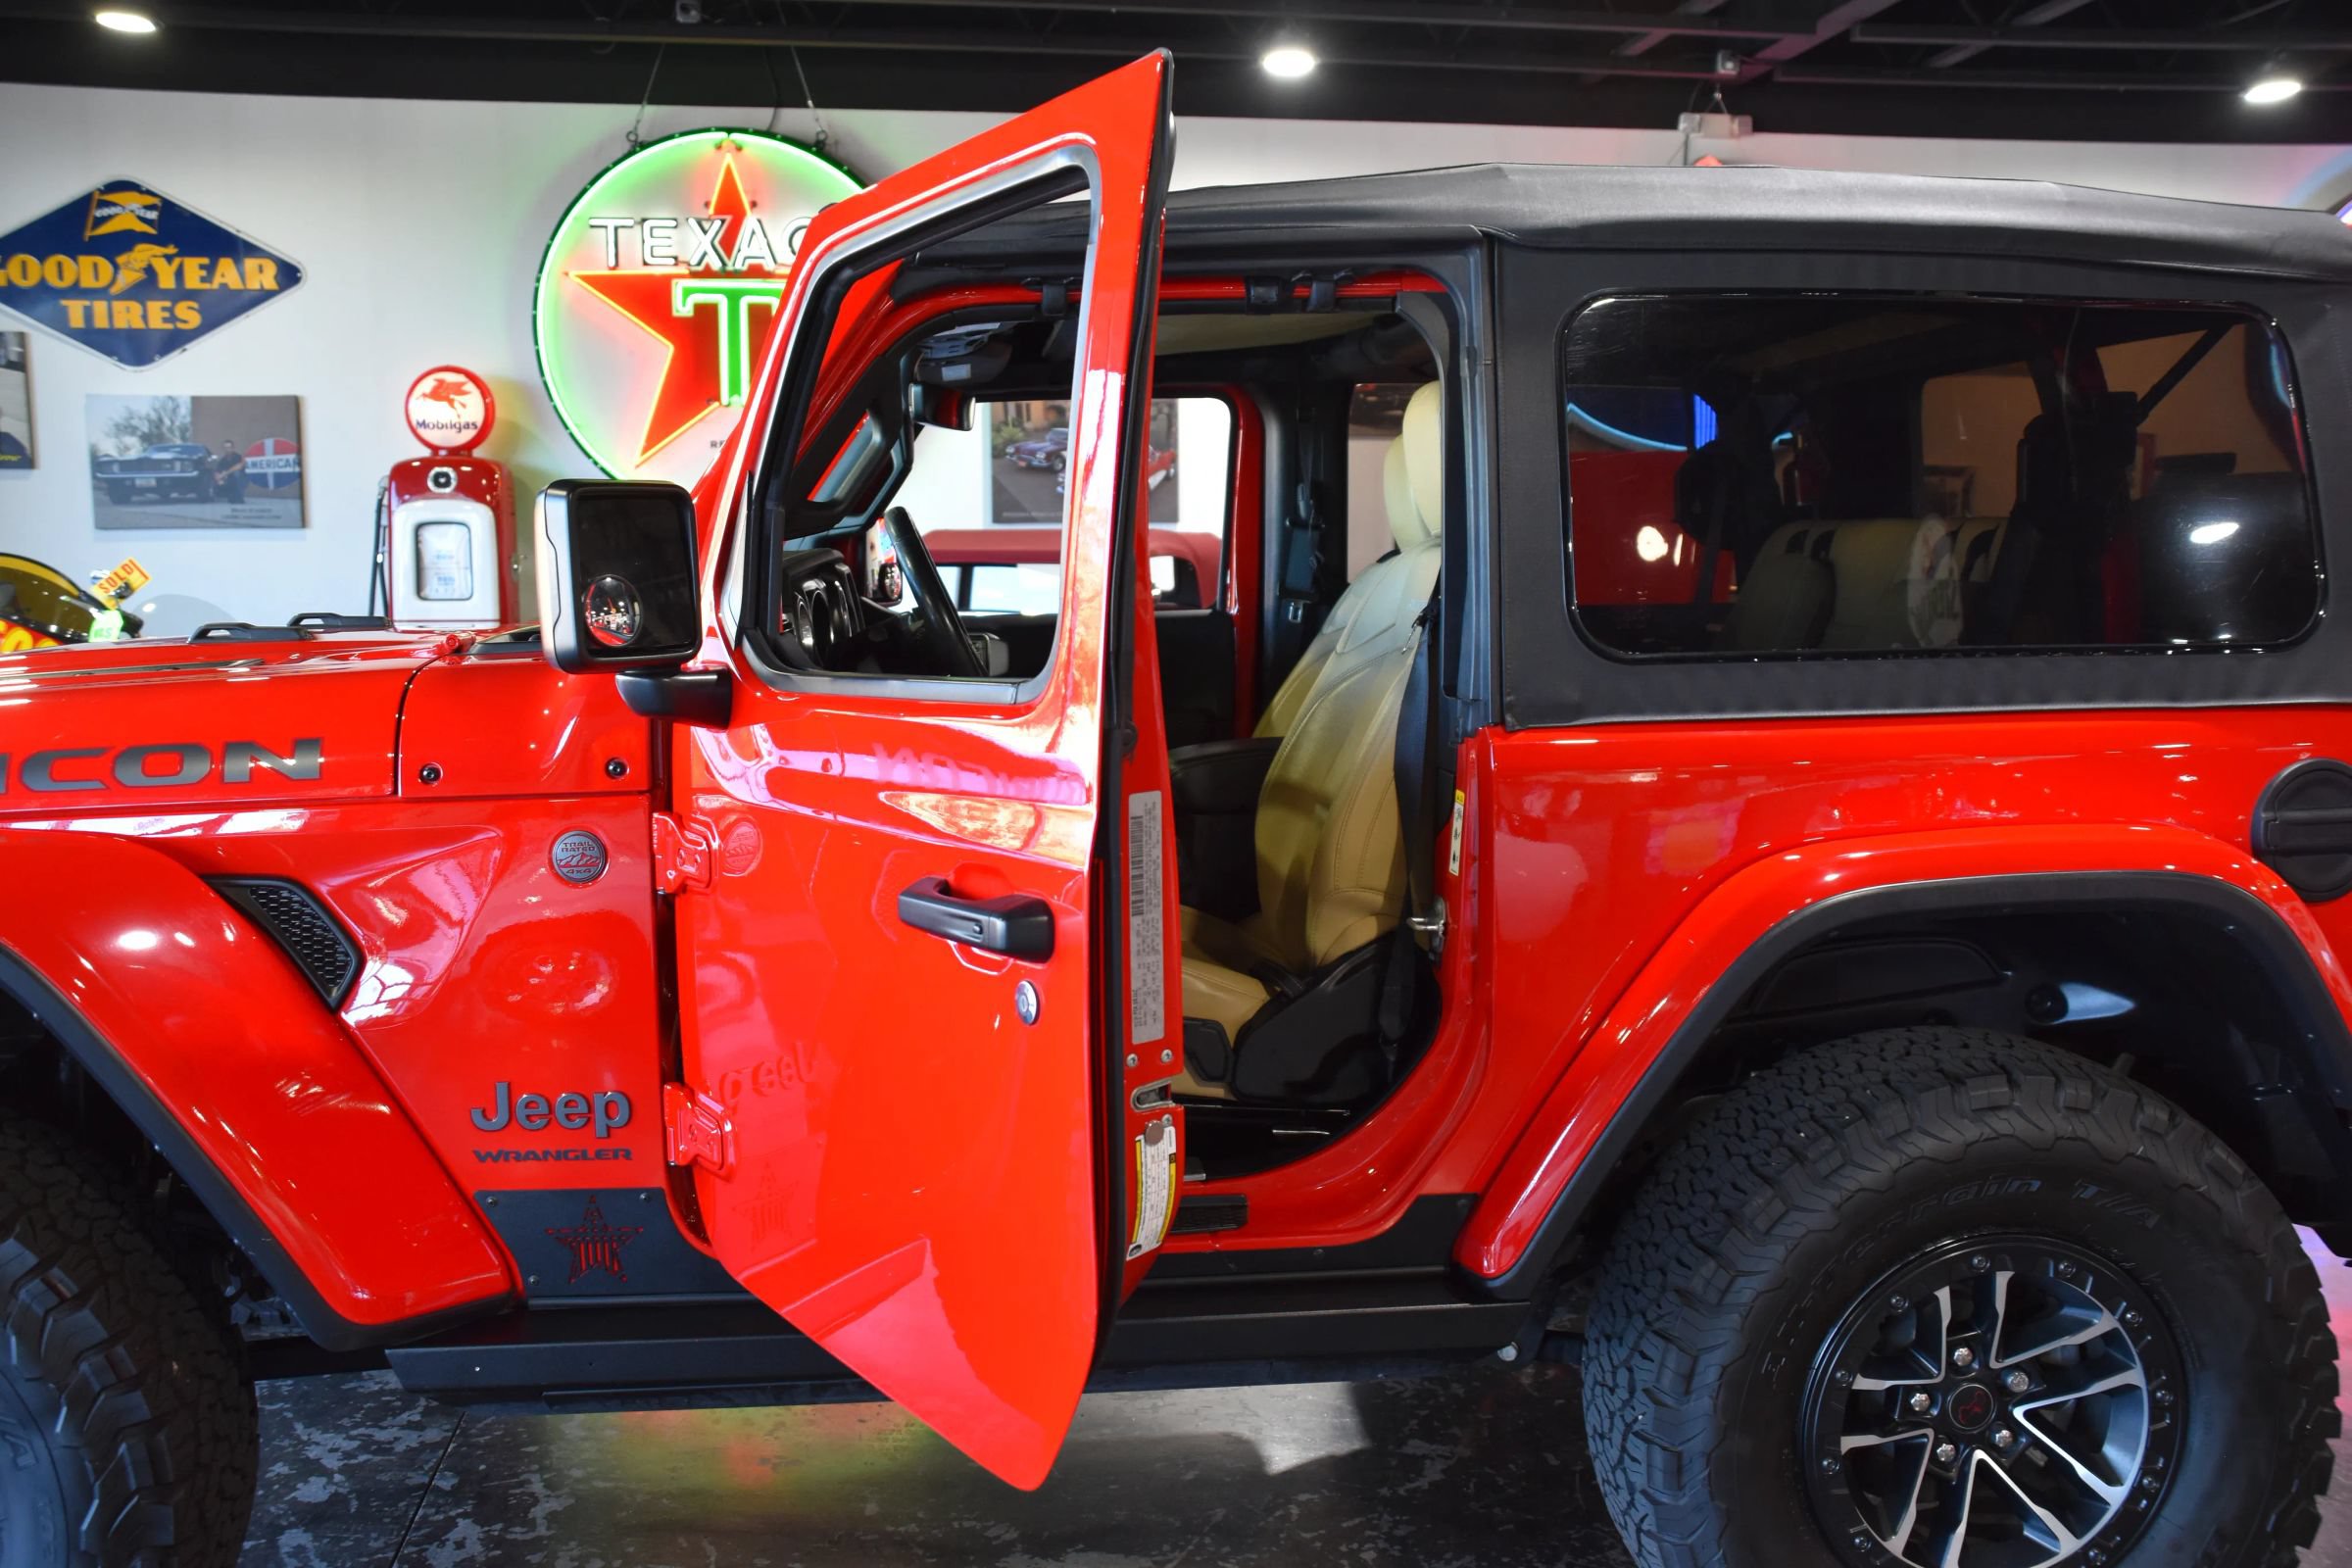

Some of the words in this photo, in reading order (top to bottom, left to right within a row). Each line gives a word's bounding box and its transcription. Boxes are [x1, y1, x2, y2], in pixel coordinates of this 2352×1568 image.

[60, 299, 202, 329] TIRES
[416, 418, 479, 434] Mobilgas
[98, 563, 134, 594] SOLD
[470, 1082, 631, 1139] Jeep
[472, 1148, 634, 1163] WRANGLER
